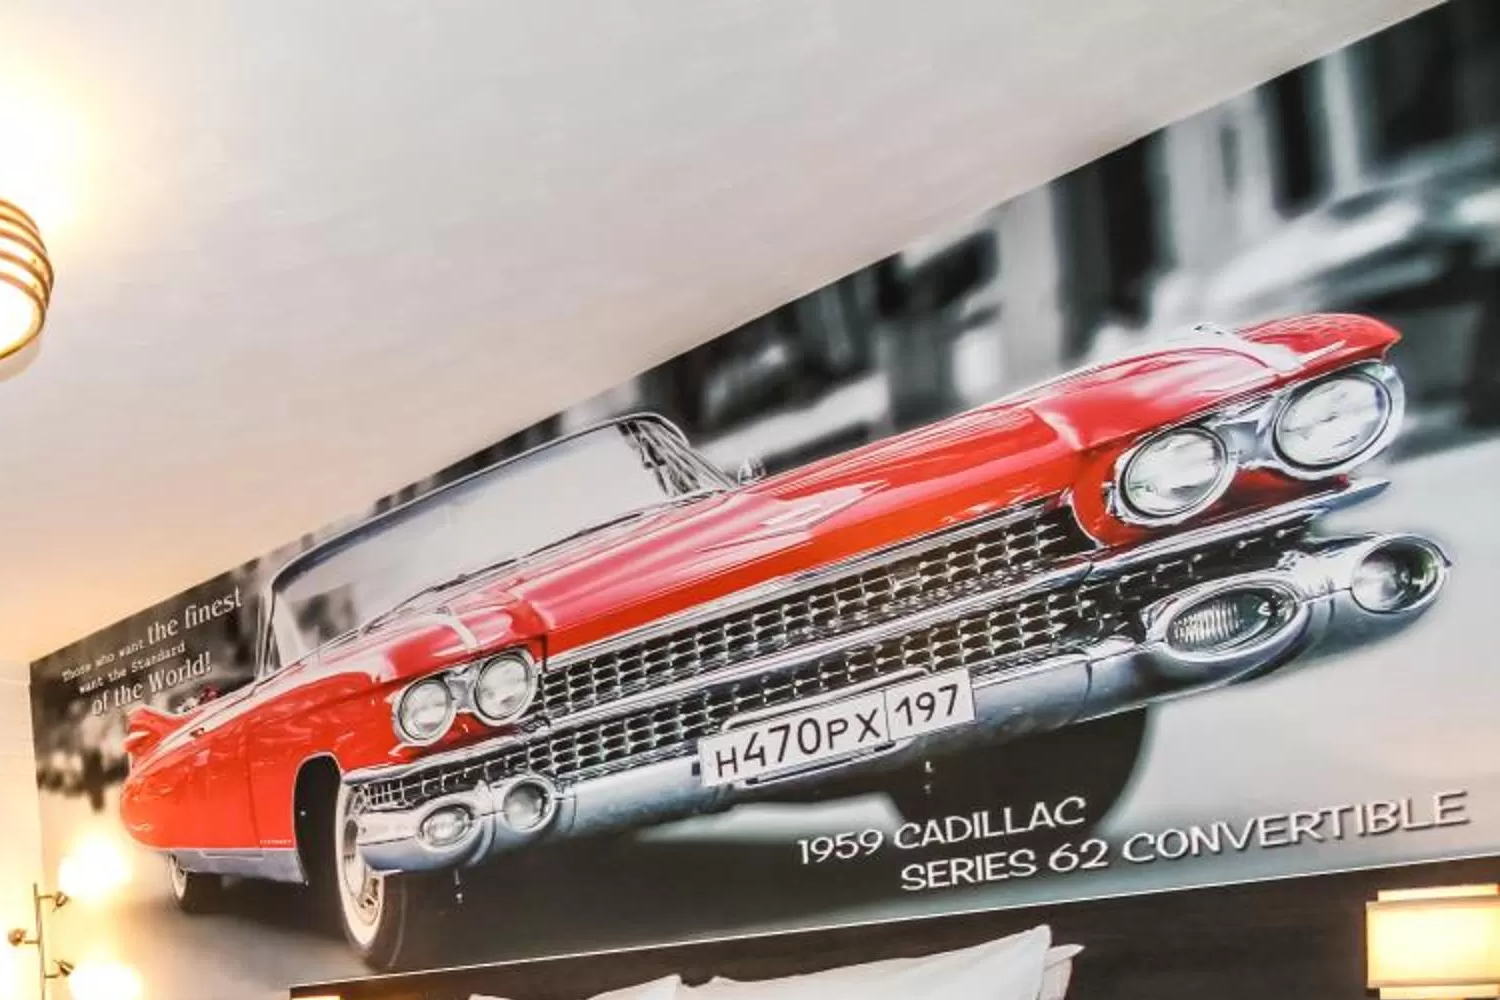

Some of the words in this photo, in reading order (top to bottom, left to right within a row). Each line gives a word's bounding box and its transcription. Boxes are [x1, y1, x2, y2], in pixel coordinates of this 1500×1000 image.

[119, 639, 144, 657] want
[147, 618, 179, 645] the
[184, 586, 242, 630] finest
[92, 690, 109, 717] of
[115, 684, 144, 708] the
[148, 651, 213, 694] World!
[107, 668, 127, 682] the
[131, 640, 186, 673] Standard
[895, 684, 959, 726] 197
[797, 829, 883, 865] 1959
[894, 796, 1086, 849] CADILLAC
[901, 849, 1037, 891] SERIES
[1049, 839, 1109, 873] 62
[1121, 789, 1471, 865] CONVERTIBLE
